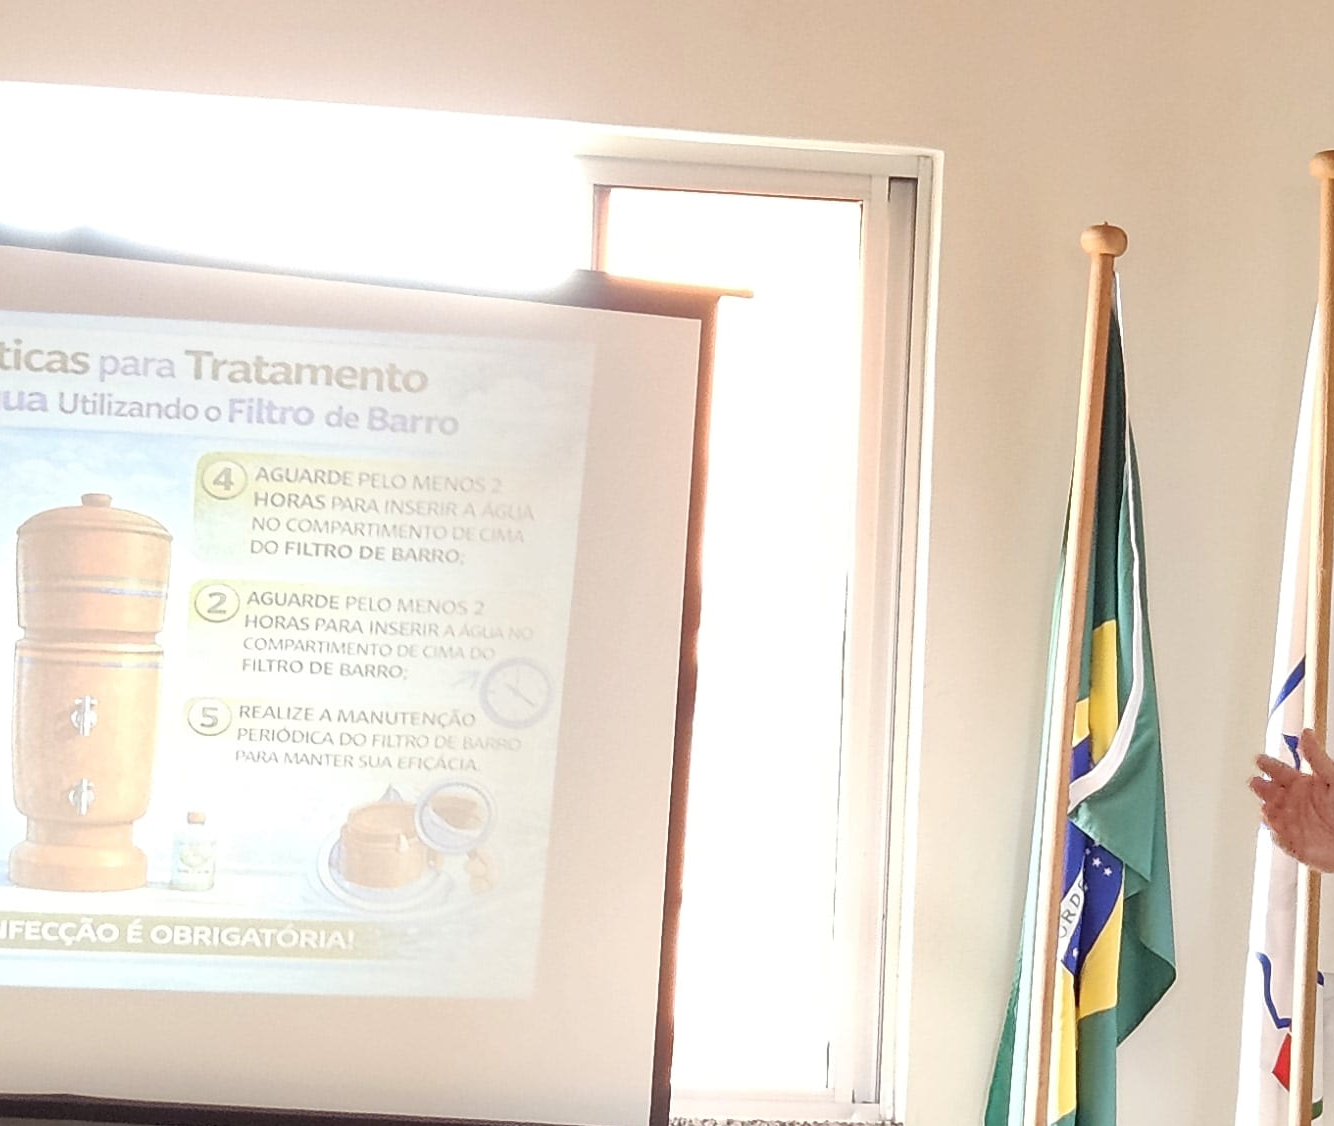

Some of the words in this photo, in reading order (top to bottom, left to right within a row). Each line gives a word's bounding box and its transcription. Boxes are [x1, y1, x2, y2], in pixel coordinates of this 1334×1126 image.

[99, 351, 175, 382] para
[185, 350, 428, 393] Tratamento
[59, 391, 199, 422] Utilizando
[205, 405, 222, 423] o
[228, 398, 315, 427] Filtro
[325, 405, 359, 429] de
[367, 408, 459, 435] Barro
[213, 468, 234, 490] 4
[254, 466, 353, 487] AGUARDE
[359, 472, 407, 490] PELO
[414, 474, 486, 493] MENOS
[491, 478, 502, 494] 2
[254, 490, 326, 511] HORAS
[332, 495, 379, 513] PARA
[385, 497, 457, 516] INSERIR
[462, 502, 476, 517] A
[252, 515, 280, 532] NO
[286, 517, 447, 540] COMPARTIMENTO
[453, 525, 476, 541] DE
[480, 526, 524, 543] CIMA
[250, 539, 278, 555] DO
[284, 541, 353, 559] FILTRO
[359, 544, 386, 560] DE
[207, 593, 227, 613] 2
[246, 590, 339, 610] AGUARDE
[346, 595, 392, 612] PELO
[397, 598, 467, 615] MENOS
[473, 600, 484, 616] 2
[245, 614, 309, 631] HORAS
[315, 617, 363, 634] PARA
[369, 620, 439, 637] INSERIR
[444, 623, 455, 637] A
[243, 637, 392, 657] COMPARTIMENTO
[397, 641, 418, 657] DE
[423, 643, 465, 660] CIMA
[470, 645, 495, 660] DO
[242, 658, 303, 675] FILTRO
[310, 660, 334, 676] DE
[340, 662, 407, 681] BARRO;
[200, 707, 219, 727] 5
[240, 705, 313, 722] REALIZE
[319, 708, 332, 723] A
[337, 708, 476, 730] MANUTENÇÃO
[237, 725, 333, 745] PERIÓDICA
[340, 732, 366, 746] DO
[372, 733, 428, 749] FILTRO
[435, 735, 457, 749] DE
[463, 736, 521, 751] BARRO
[235, 749, 278, 764] PARA
[284, 751, 354, 766] MANTER
[359, 754, 392, 769] SUA
[127, 915, 143, 941] É
[149, 921, 355, 951] OBRIGATÓRIA!
